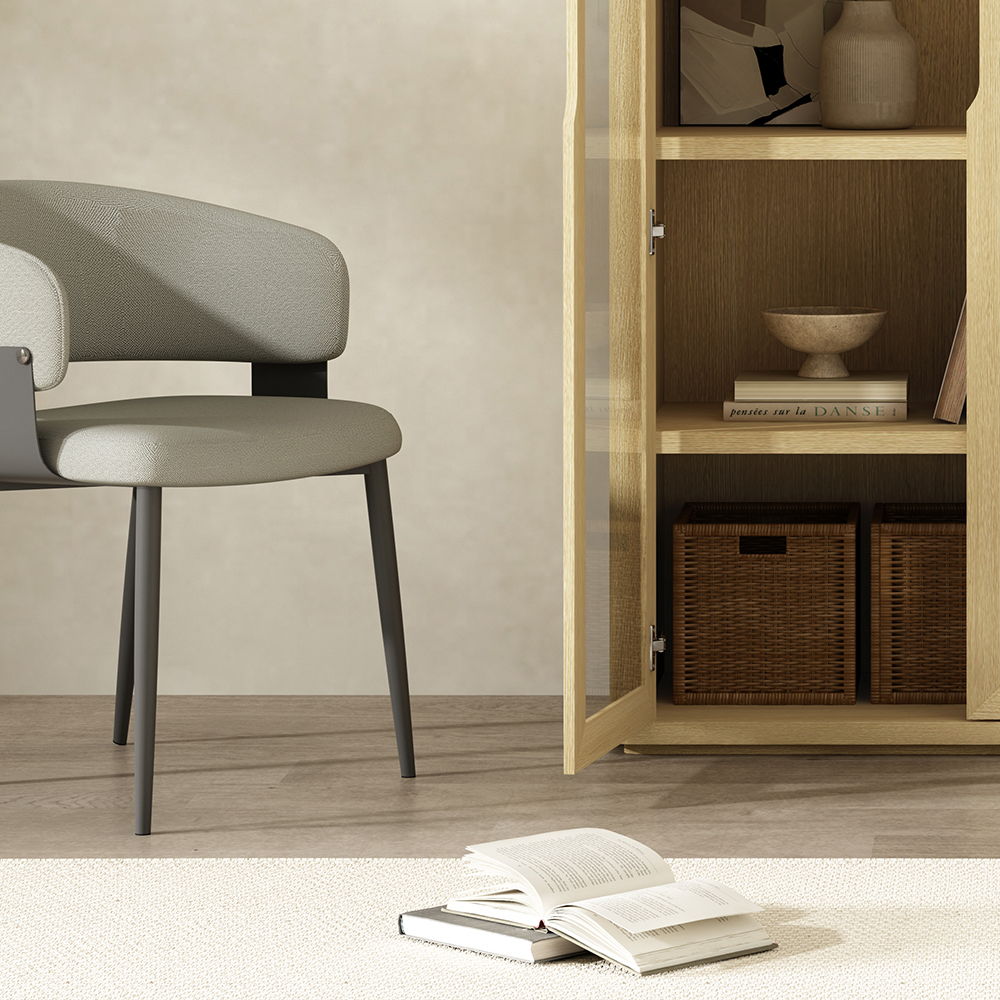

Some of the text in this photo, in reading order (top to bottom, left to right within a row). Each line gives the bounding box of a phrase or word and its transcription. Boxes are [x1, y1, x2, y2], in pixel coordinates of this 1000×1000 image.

[772, 408, 791, 416] sur
[795, 406, 807, 416] la
[814, 406, 886, 417] DANSE
